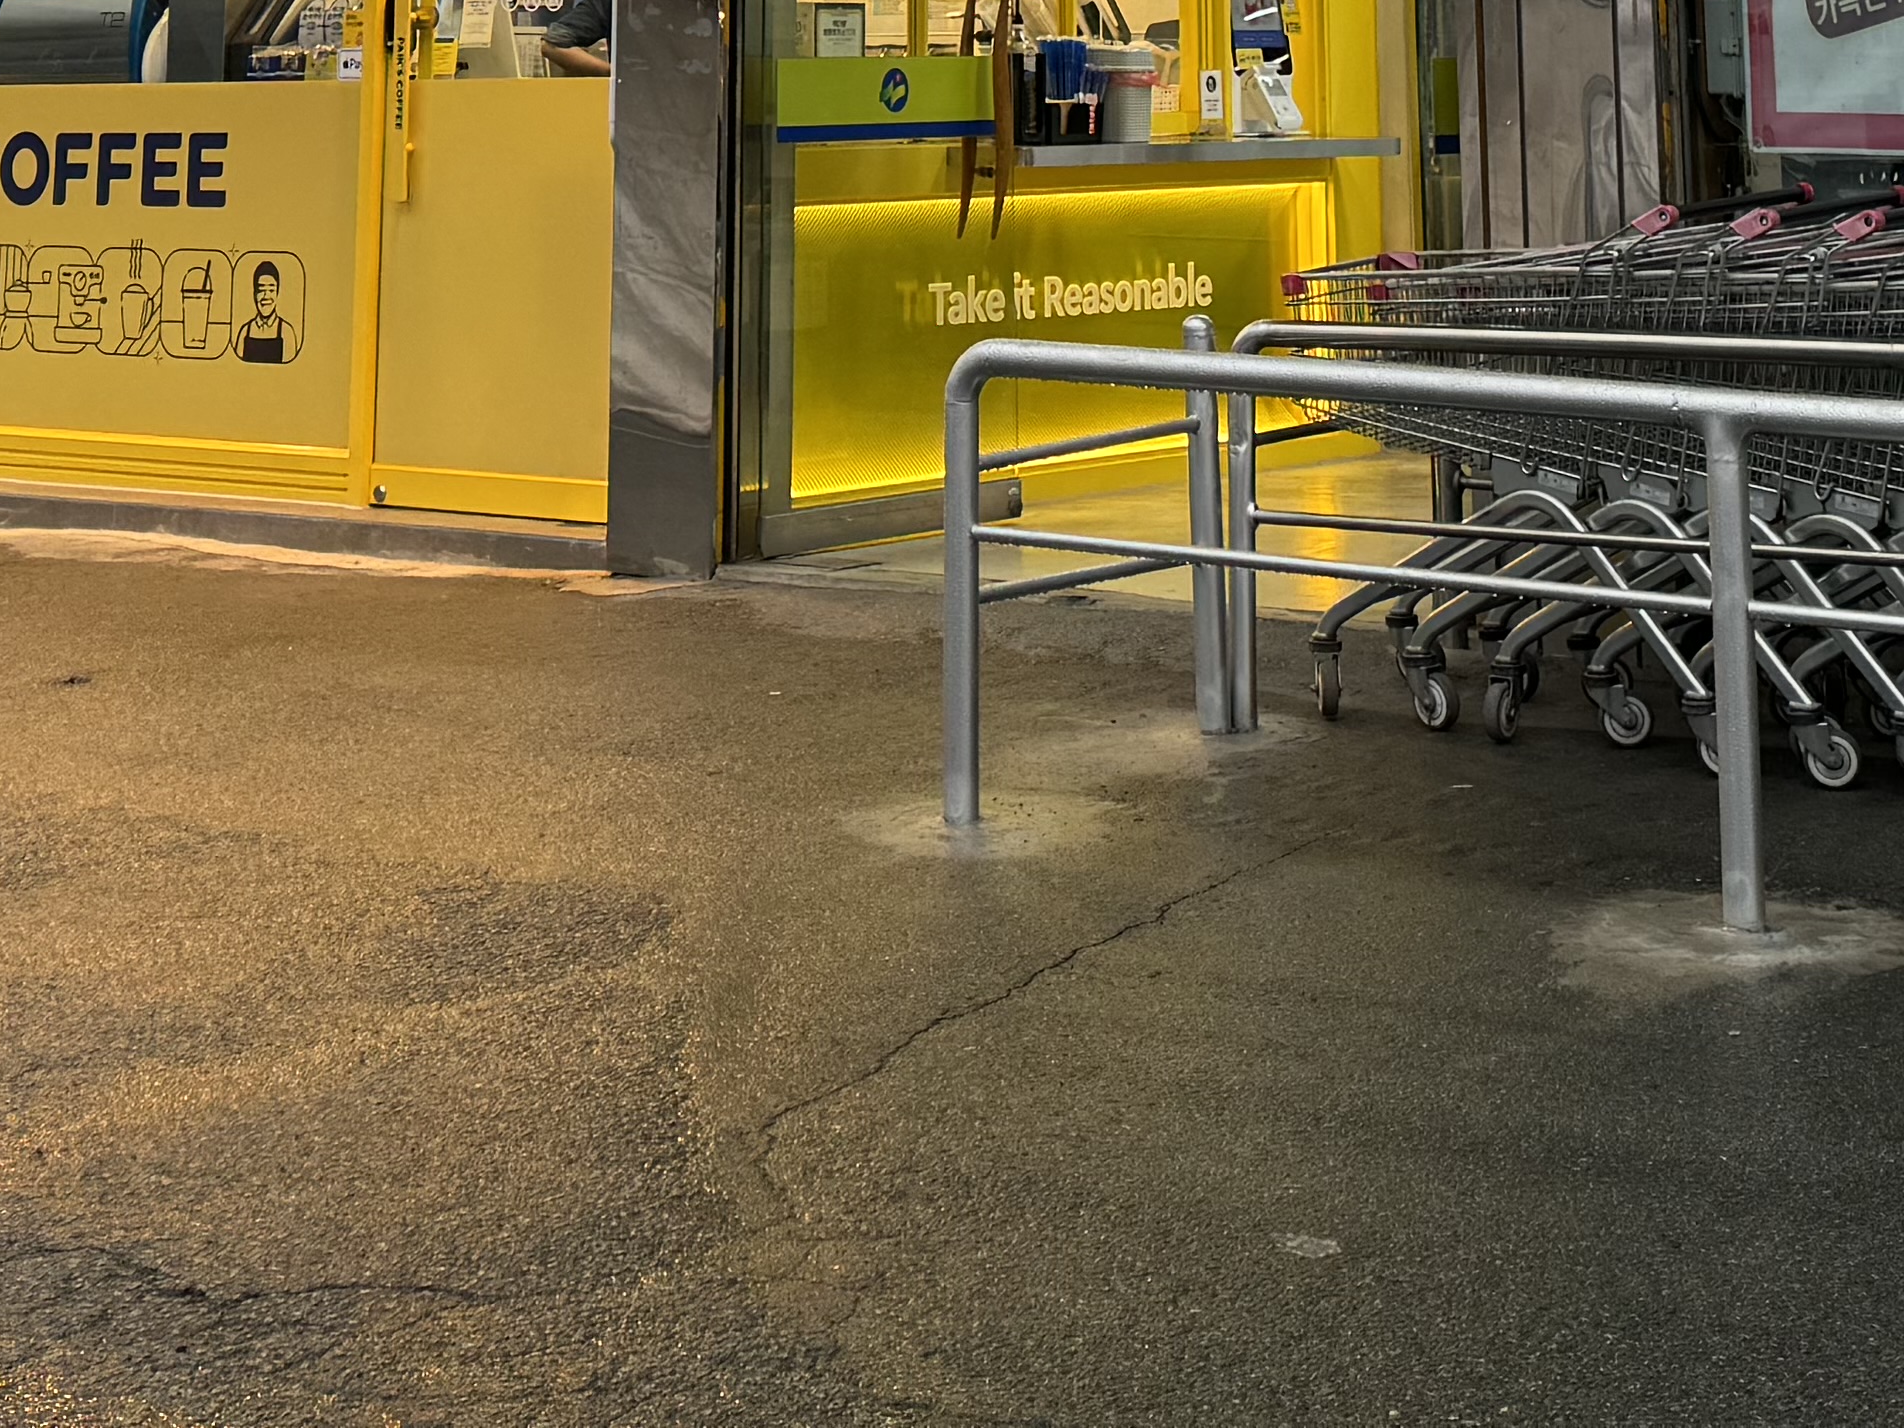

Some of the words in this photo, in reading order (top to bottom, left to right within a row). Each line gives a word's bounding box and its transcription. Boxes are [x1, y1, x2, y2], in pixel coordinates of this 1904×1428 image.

[928, 280, 1005, 327] Take
[1013, 272, 1036, 321] it
[1043, 262, 1214, 319] Reasonable
